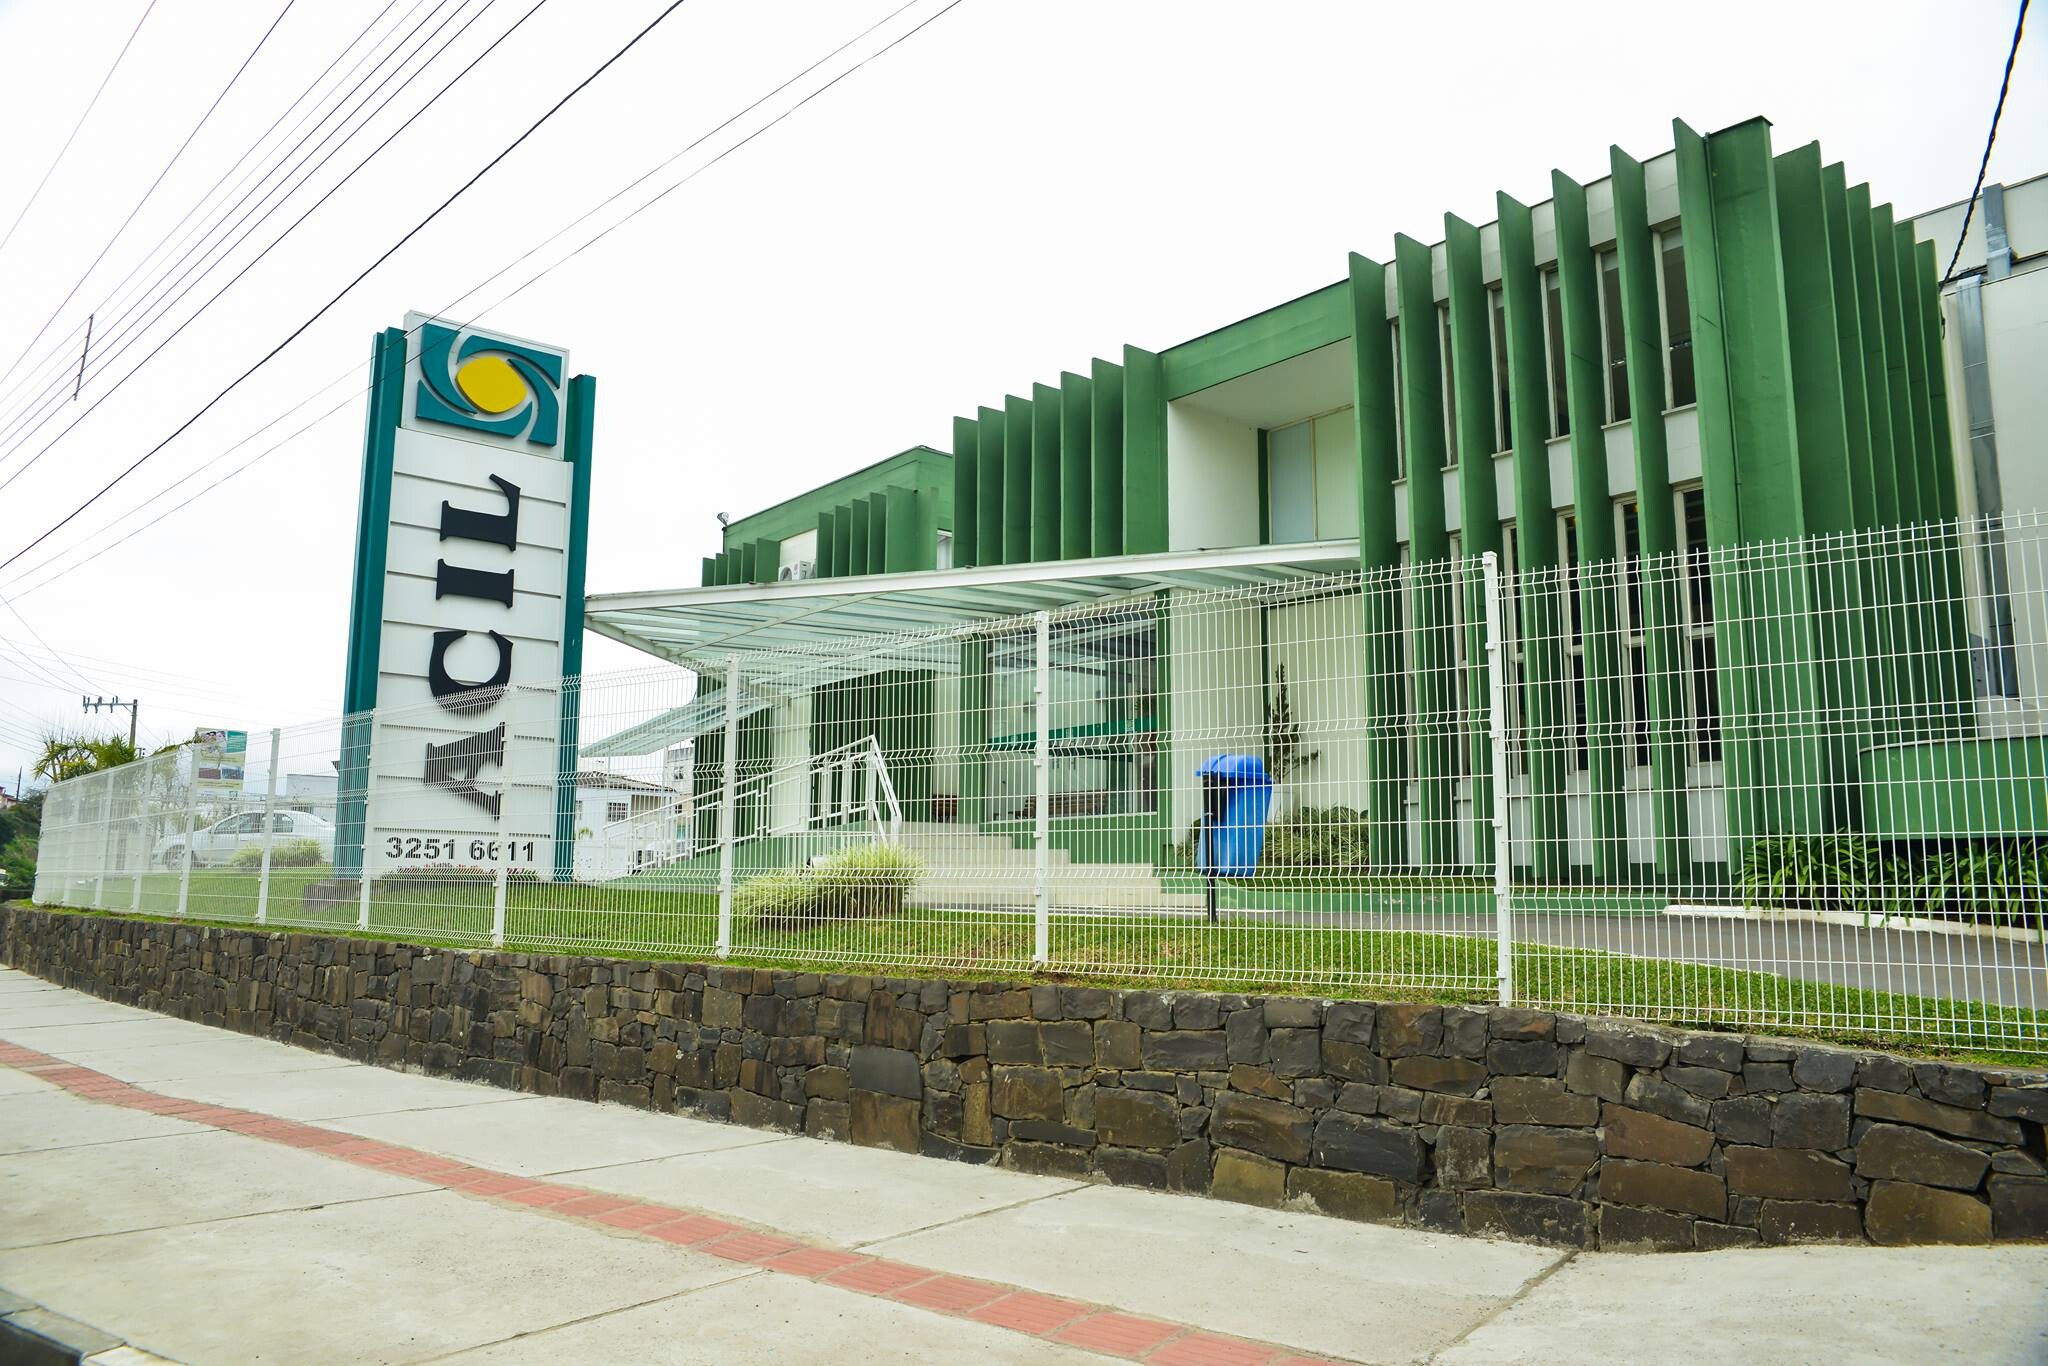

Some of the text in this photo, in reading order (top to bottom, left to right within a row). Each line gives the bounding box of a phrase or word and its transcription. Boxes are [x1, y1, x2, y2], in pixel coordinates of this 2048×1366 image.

[424, 473, 521, 821] ACIL
[385, 836, 534, 862] 3251 6611
